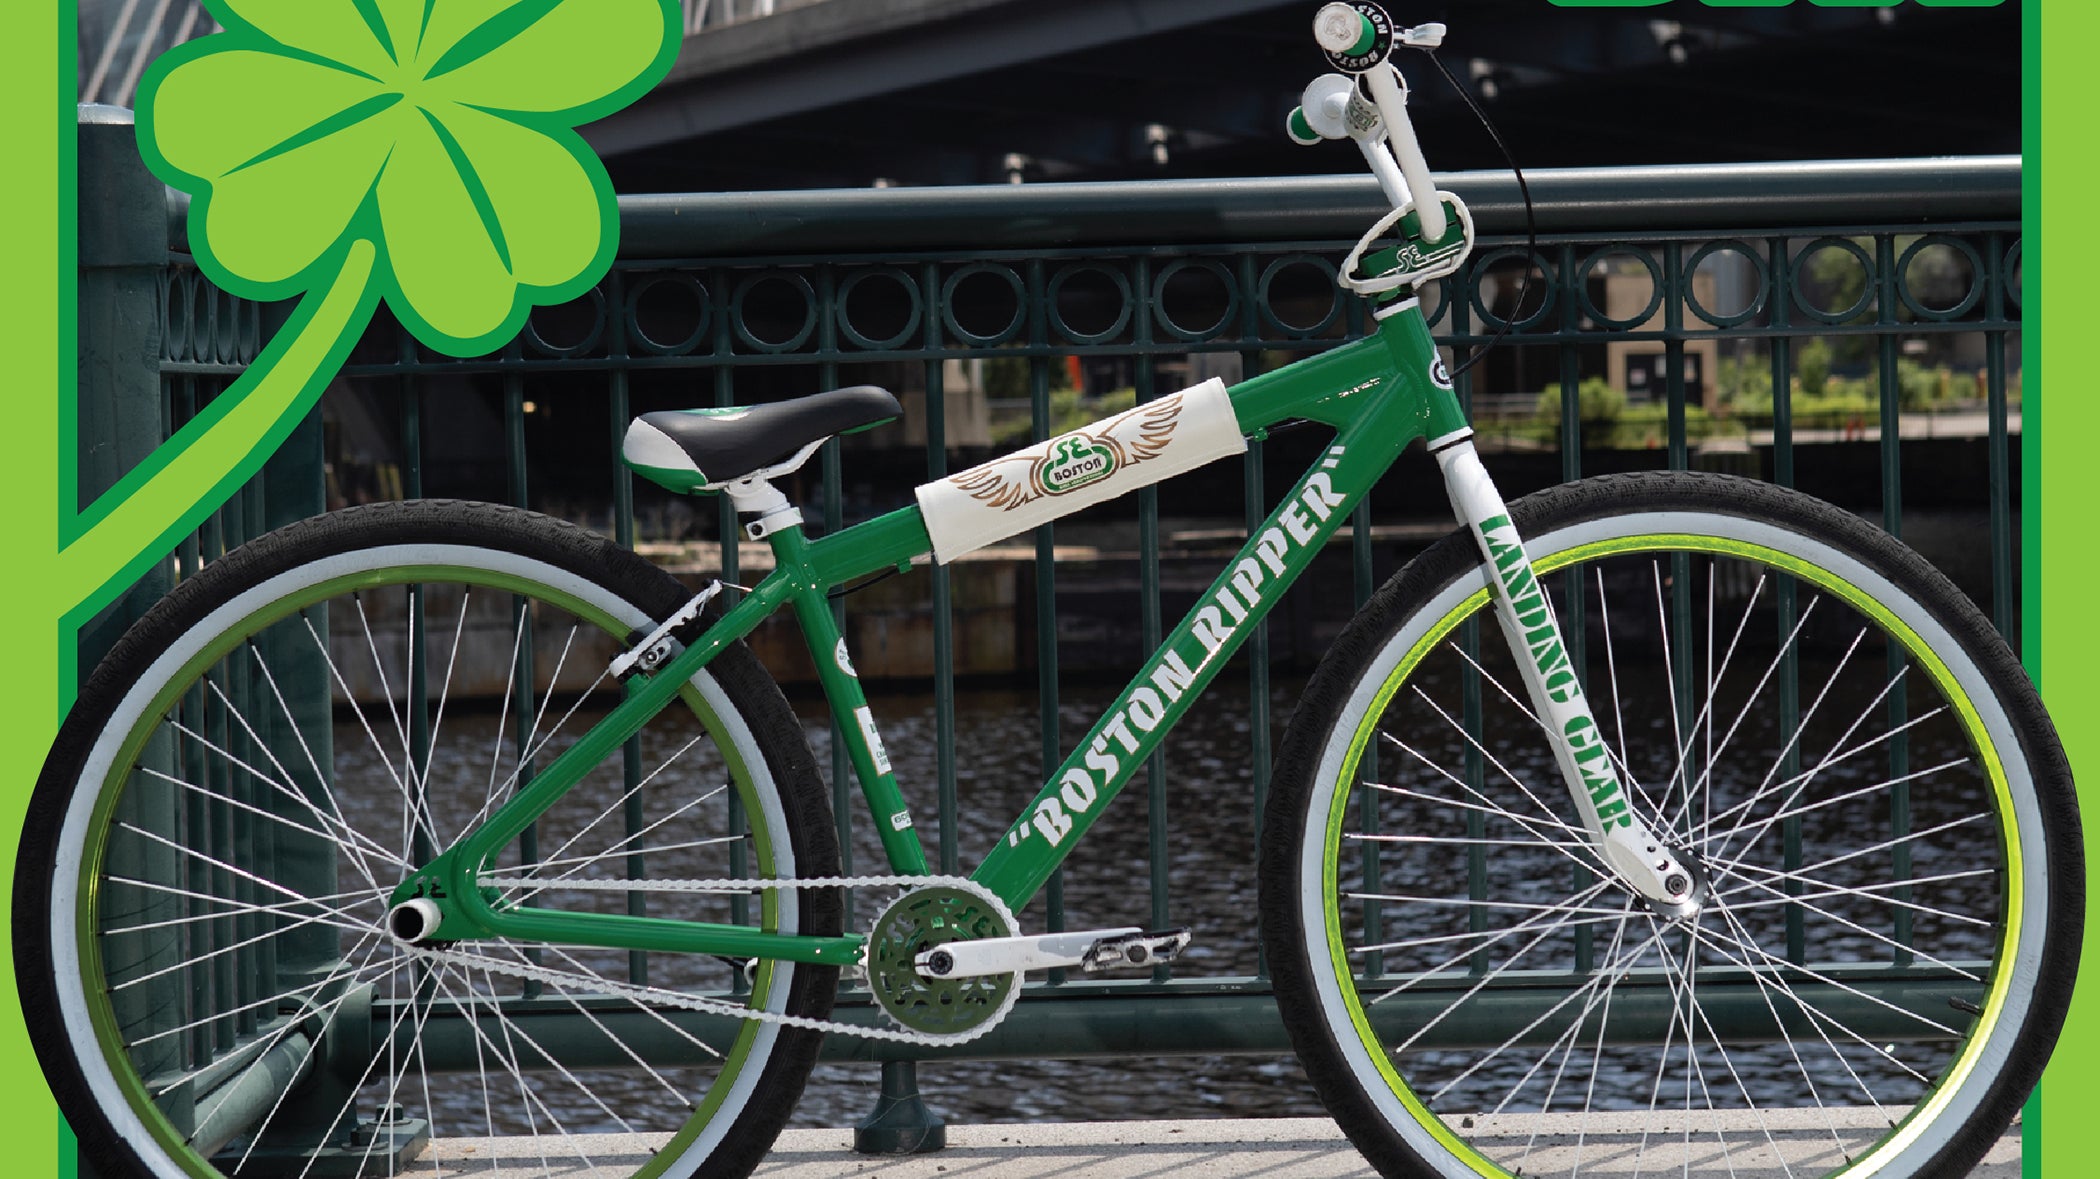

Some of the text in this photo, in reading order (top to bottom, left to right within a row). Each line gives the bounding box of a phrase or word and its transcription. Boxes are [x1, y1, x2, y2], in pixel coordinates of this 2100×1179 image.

[1350, 4, 1389, 35] STON
[1332, 49, 1379, 68] BOSTO
[1056, 437, 1093, 466] SE
[1054, 457, 1102, 481] BOSTON
[1478, 513, 1632, 836] LANDING GEAR
